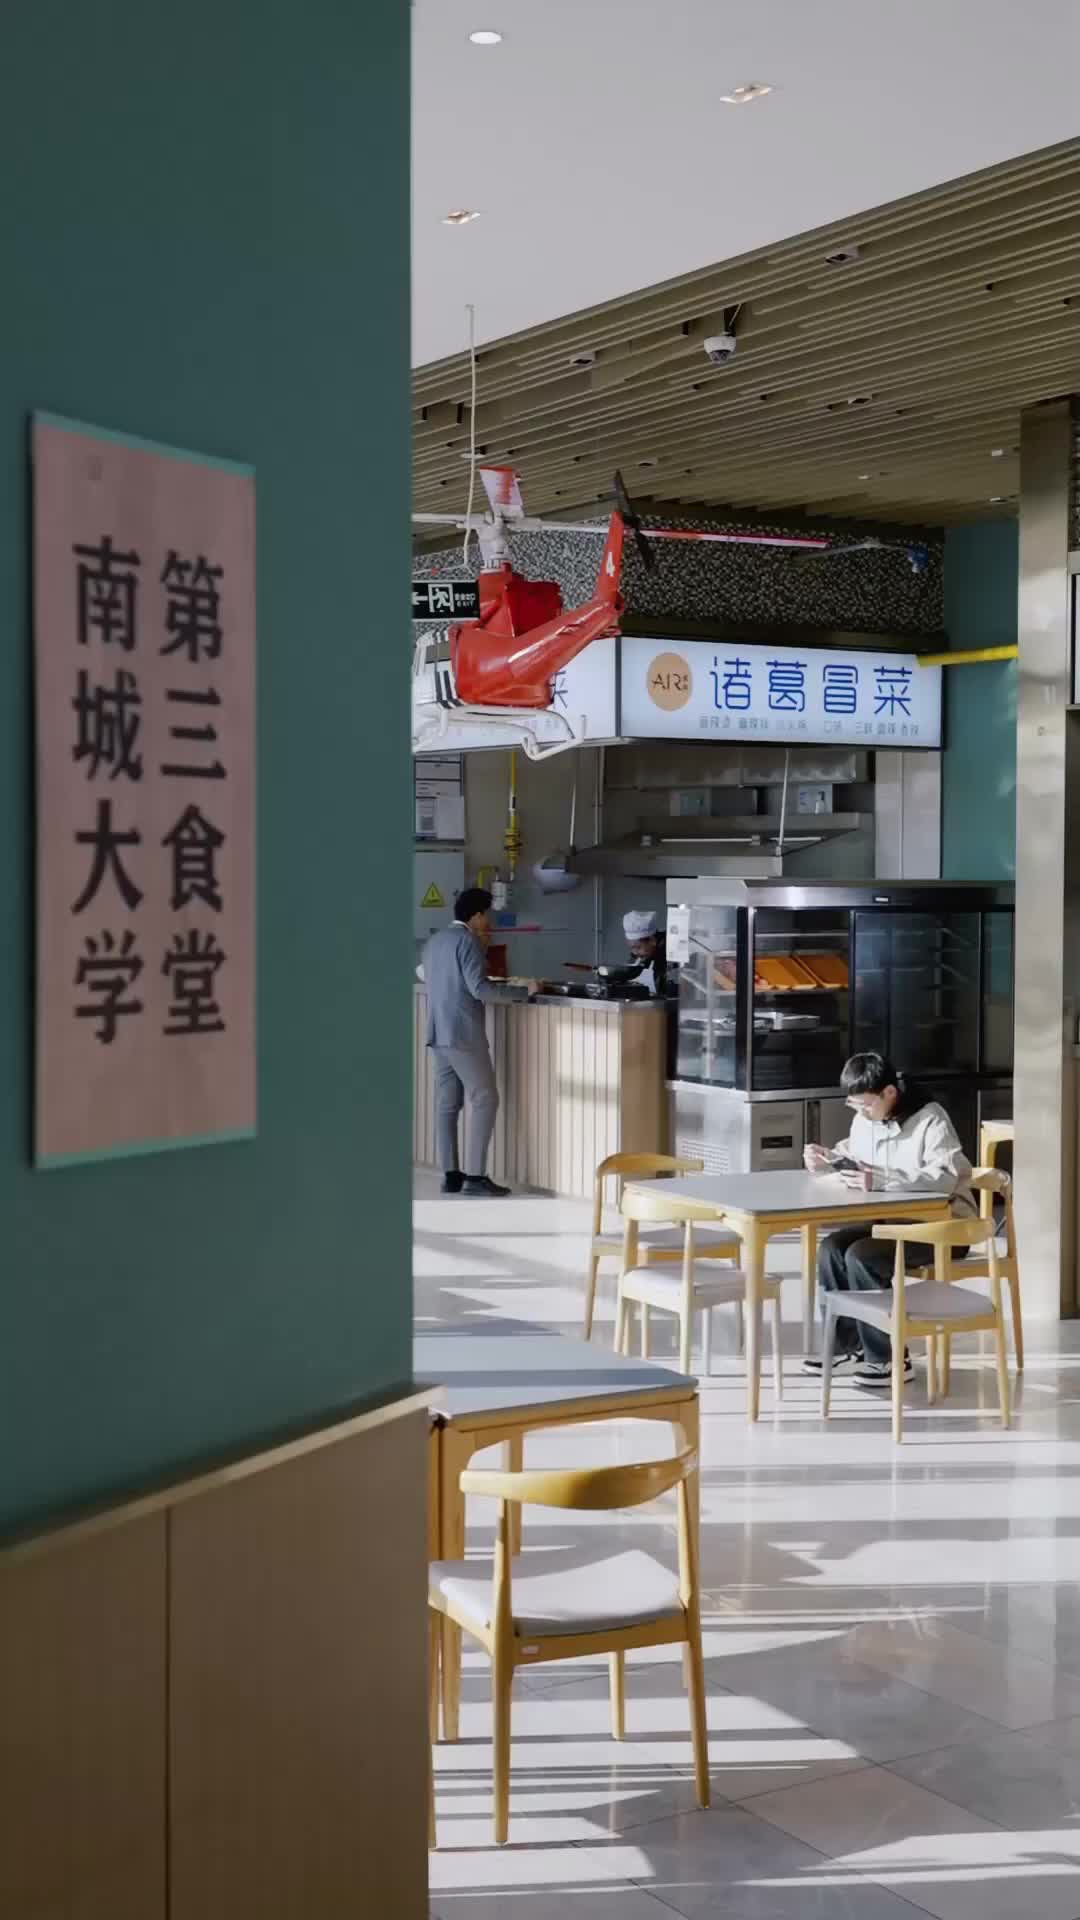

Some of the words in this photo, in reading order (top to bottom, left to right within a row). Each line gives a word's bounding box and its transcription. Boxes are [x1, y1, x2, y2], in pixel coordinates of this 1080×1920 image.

[71, 535, 144, 1044] 南城大学
[158, 548, 228, 1037] 第三食堂
[709, 655, 913, 716] 诸葛冒菜
